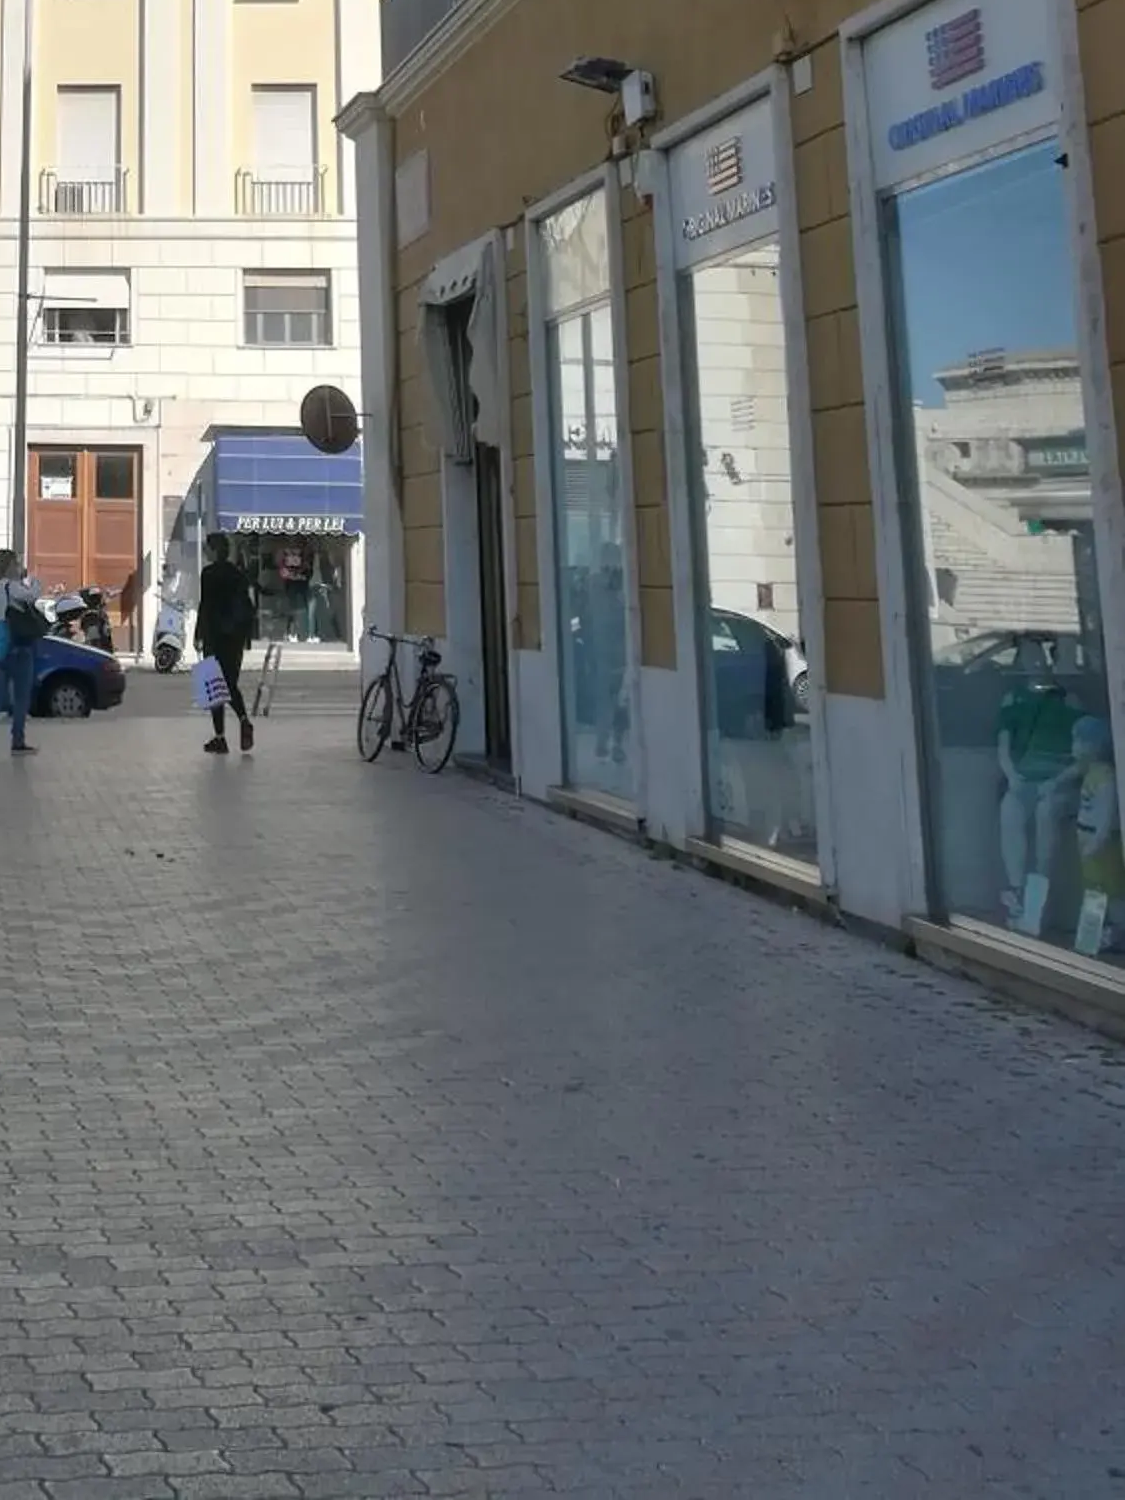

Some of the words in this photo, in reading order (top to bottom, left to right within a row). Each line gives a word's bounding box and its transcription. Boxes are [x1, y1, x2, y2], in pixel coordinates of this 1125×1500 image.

[236, 516, 260, 530] PER
[262, 516, 285, 531] LUI
[297, 516, 322, 531] PER
[323, 517, 345, 531] LEI
